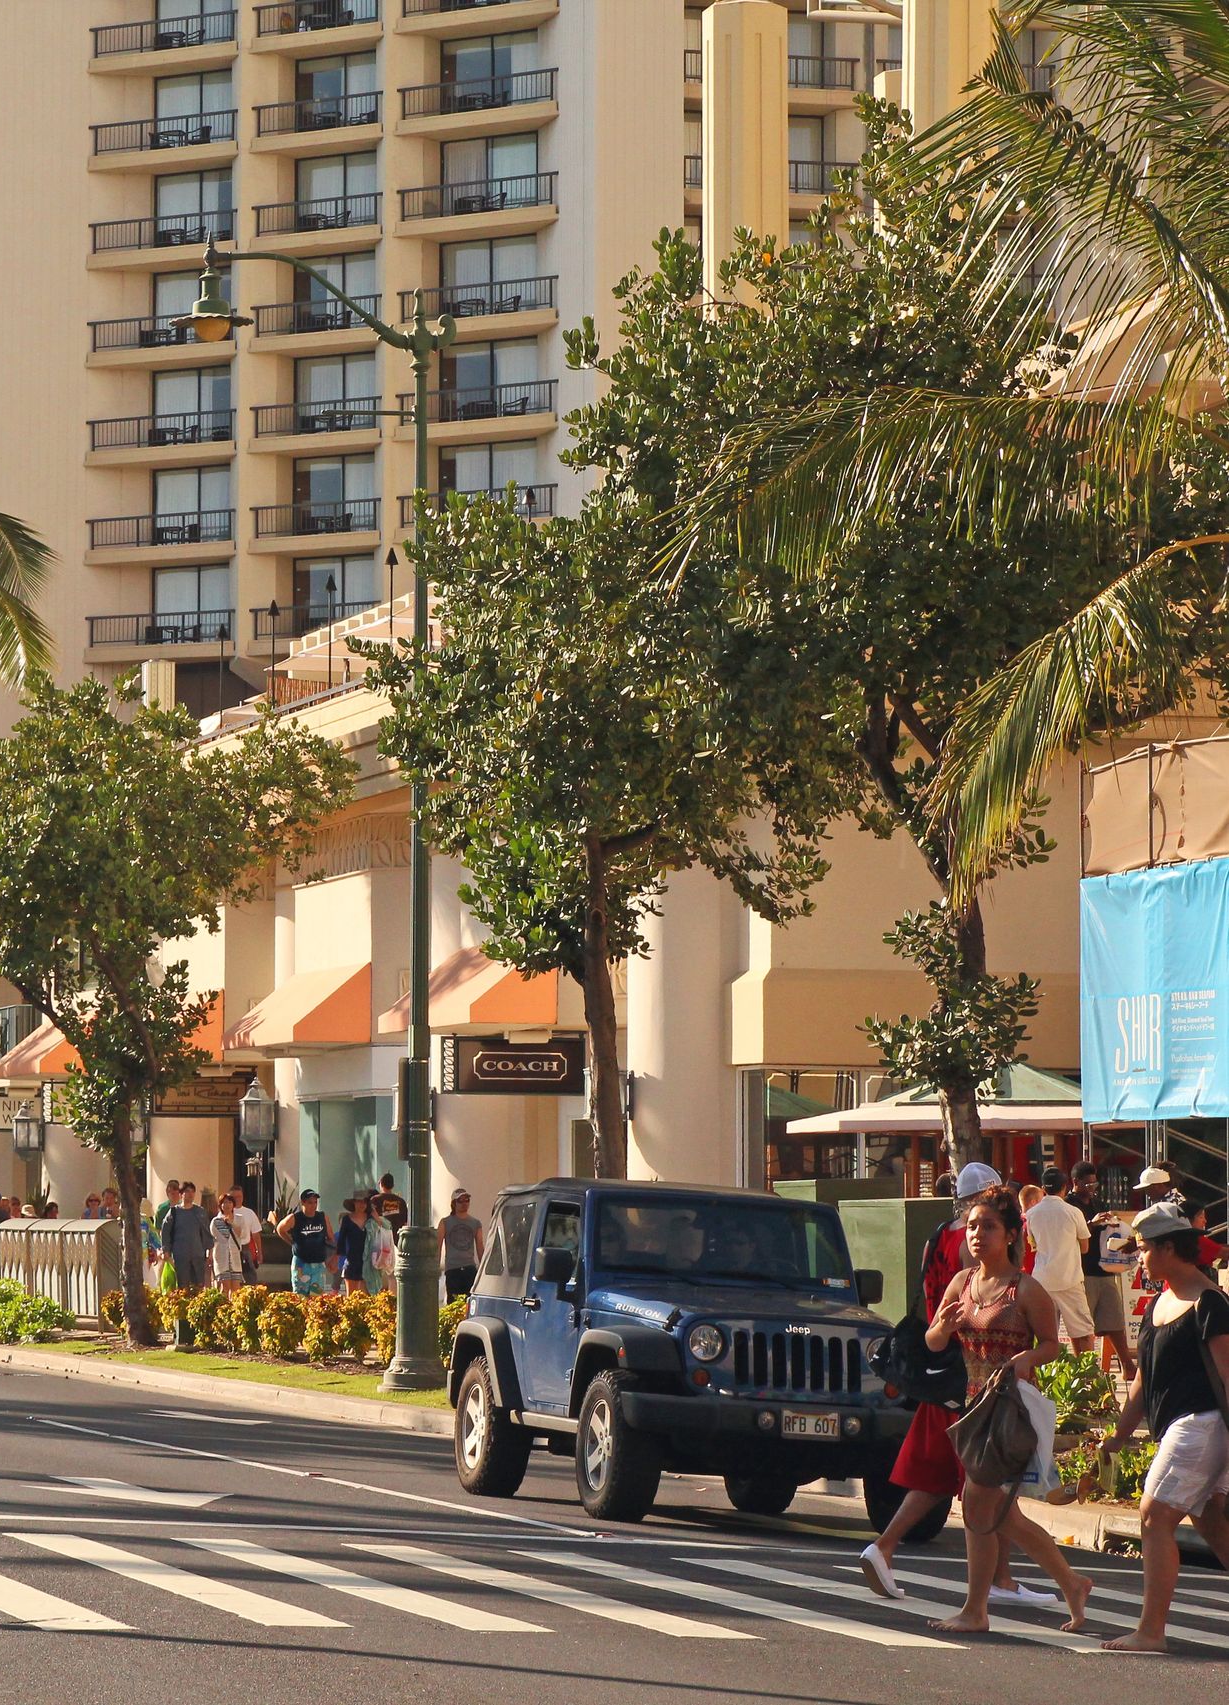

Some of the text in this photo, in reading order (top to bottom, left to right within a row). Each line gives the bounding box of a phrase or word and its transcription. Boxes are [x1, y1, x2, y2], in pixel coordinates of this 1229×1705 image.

[482, 1060, 559, 1072] COACH
[615, 1302, 662, 1319] RUBICON
[785, 1324, 811, 1335] Jeep
[784, 1416, 837, 1435] RFB 607
